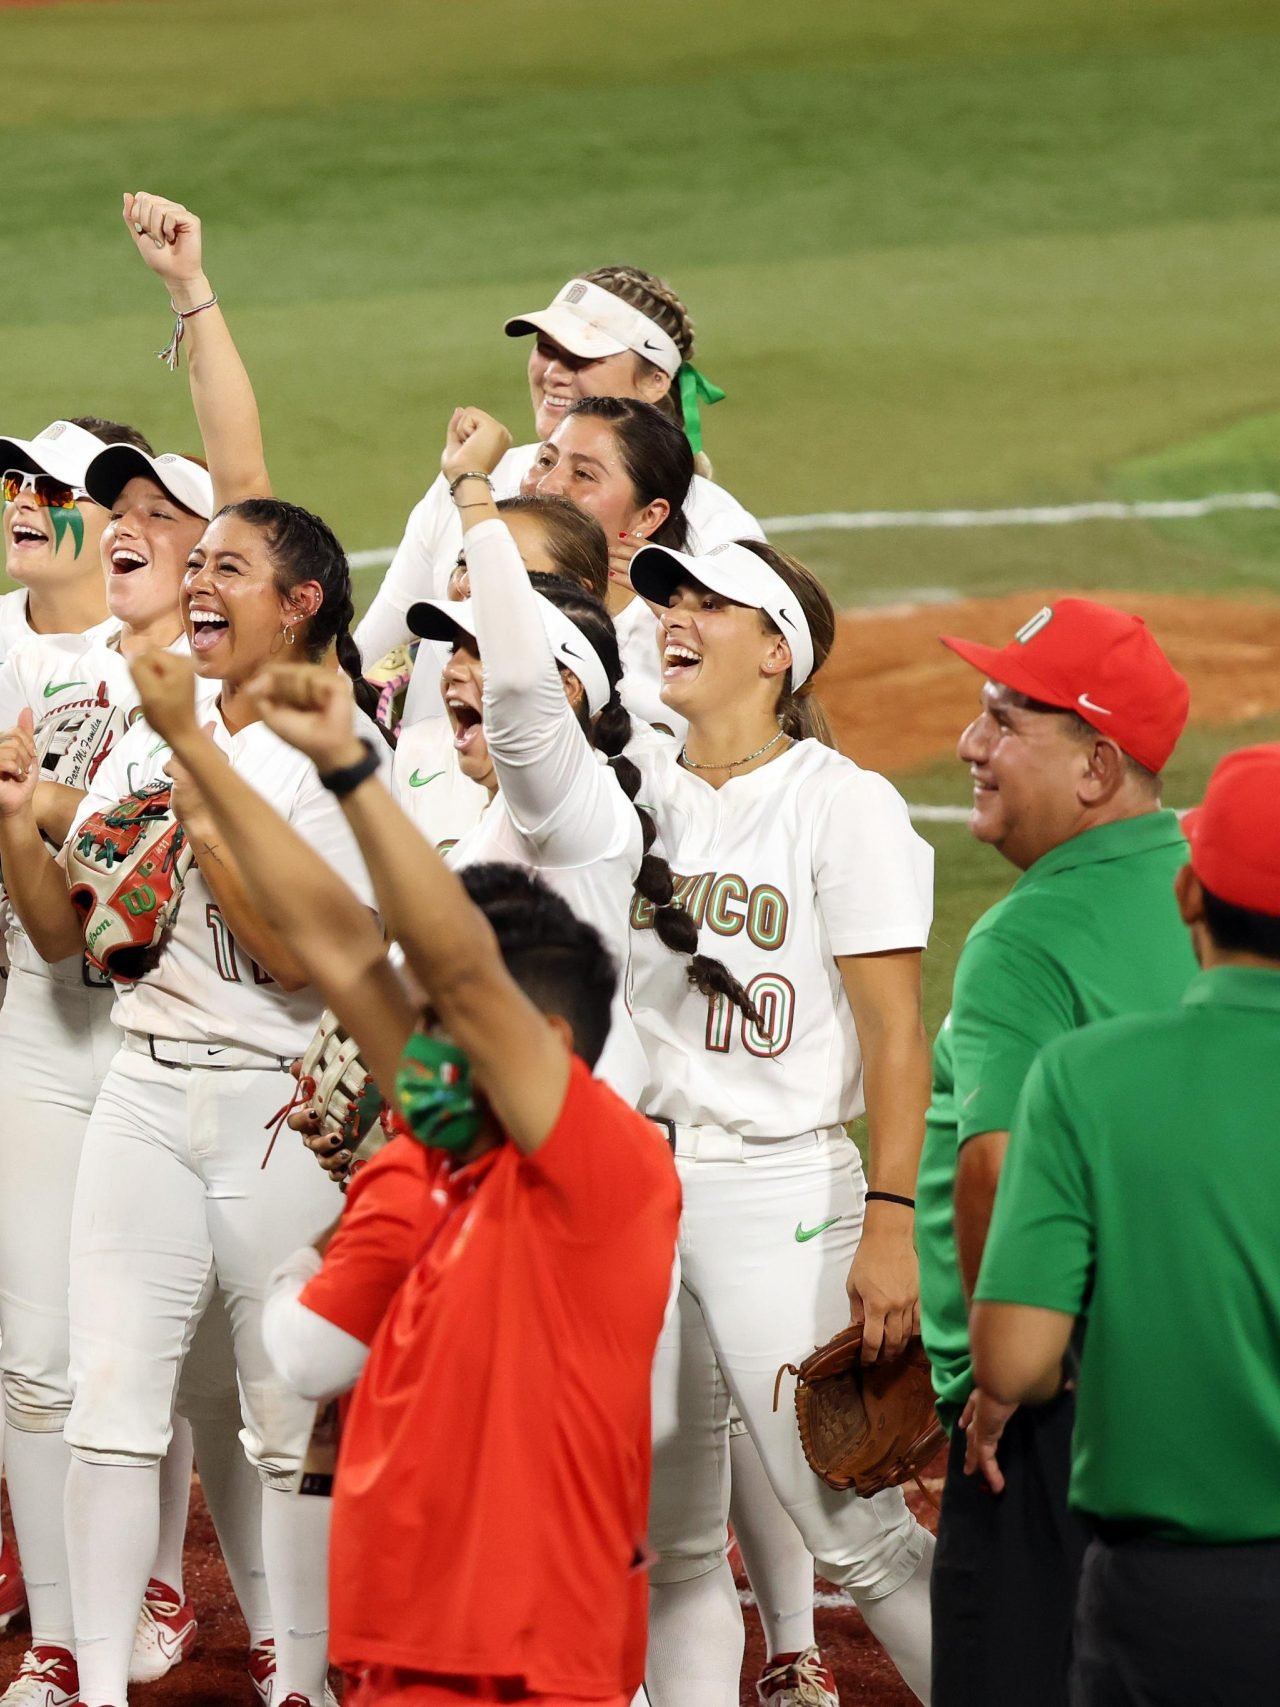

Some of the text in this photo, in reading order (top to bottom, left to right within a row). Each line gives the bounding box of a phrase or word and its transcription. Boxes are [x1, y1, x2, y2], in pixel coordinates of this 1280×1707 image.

[65, 718, 102, 787] Para Mi Familia
[87, 918, 112, 954] ilson
[705, 972, 796, 1059] 10
